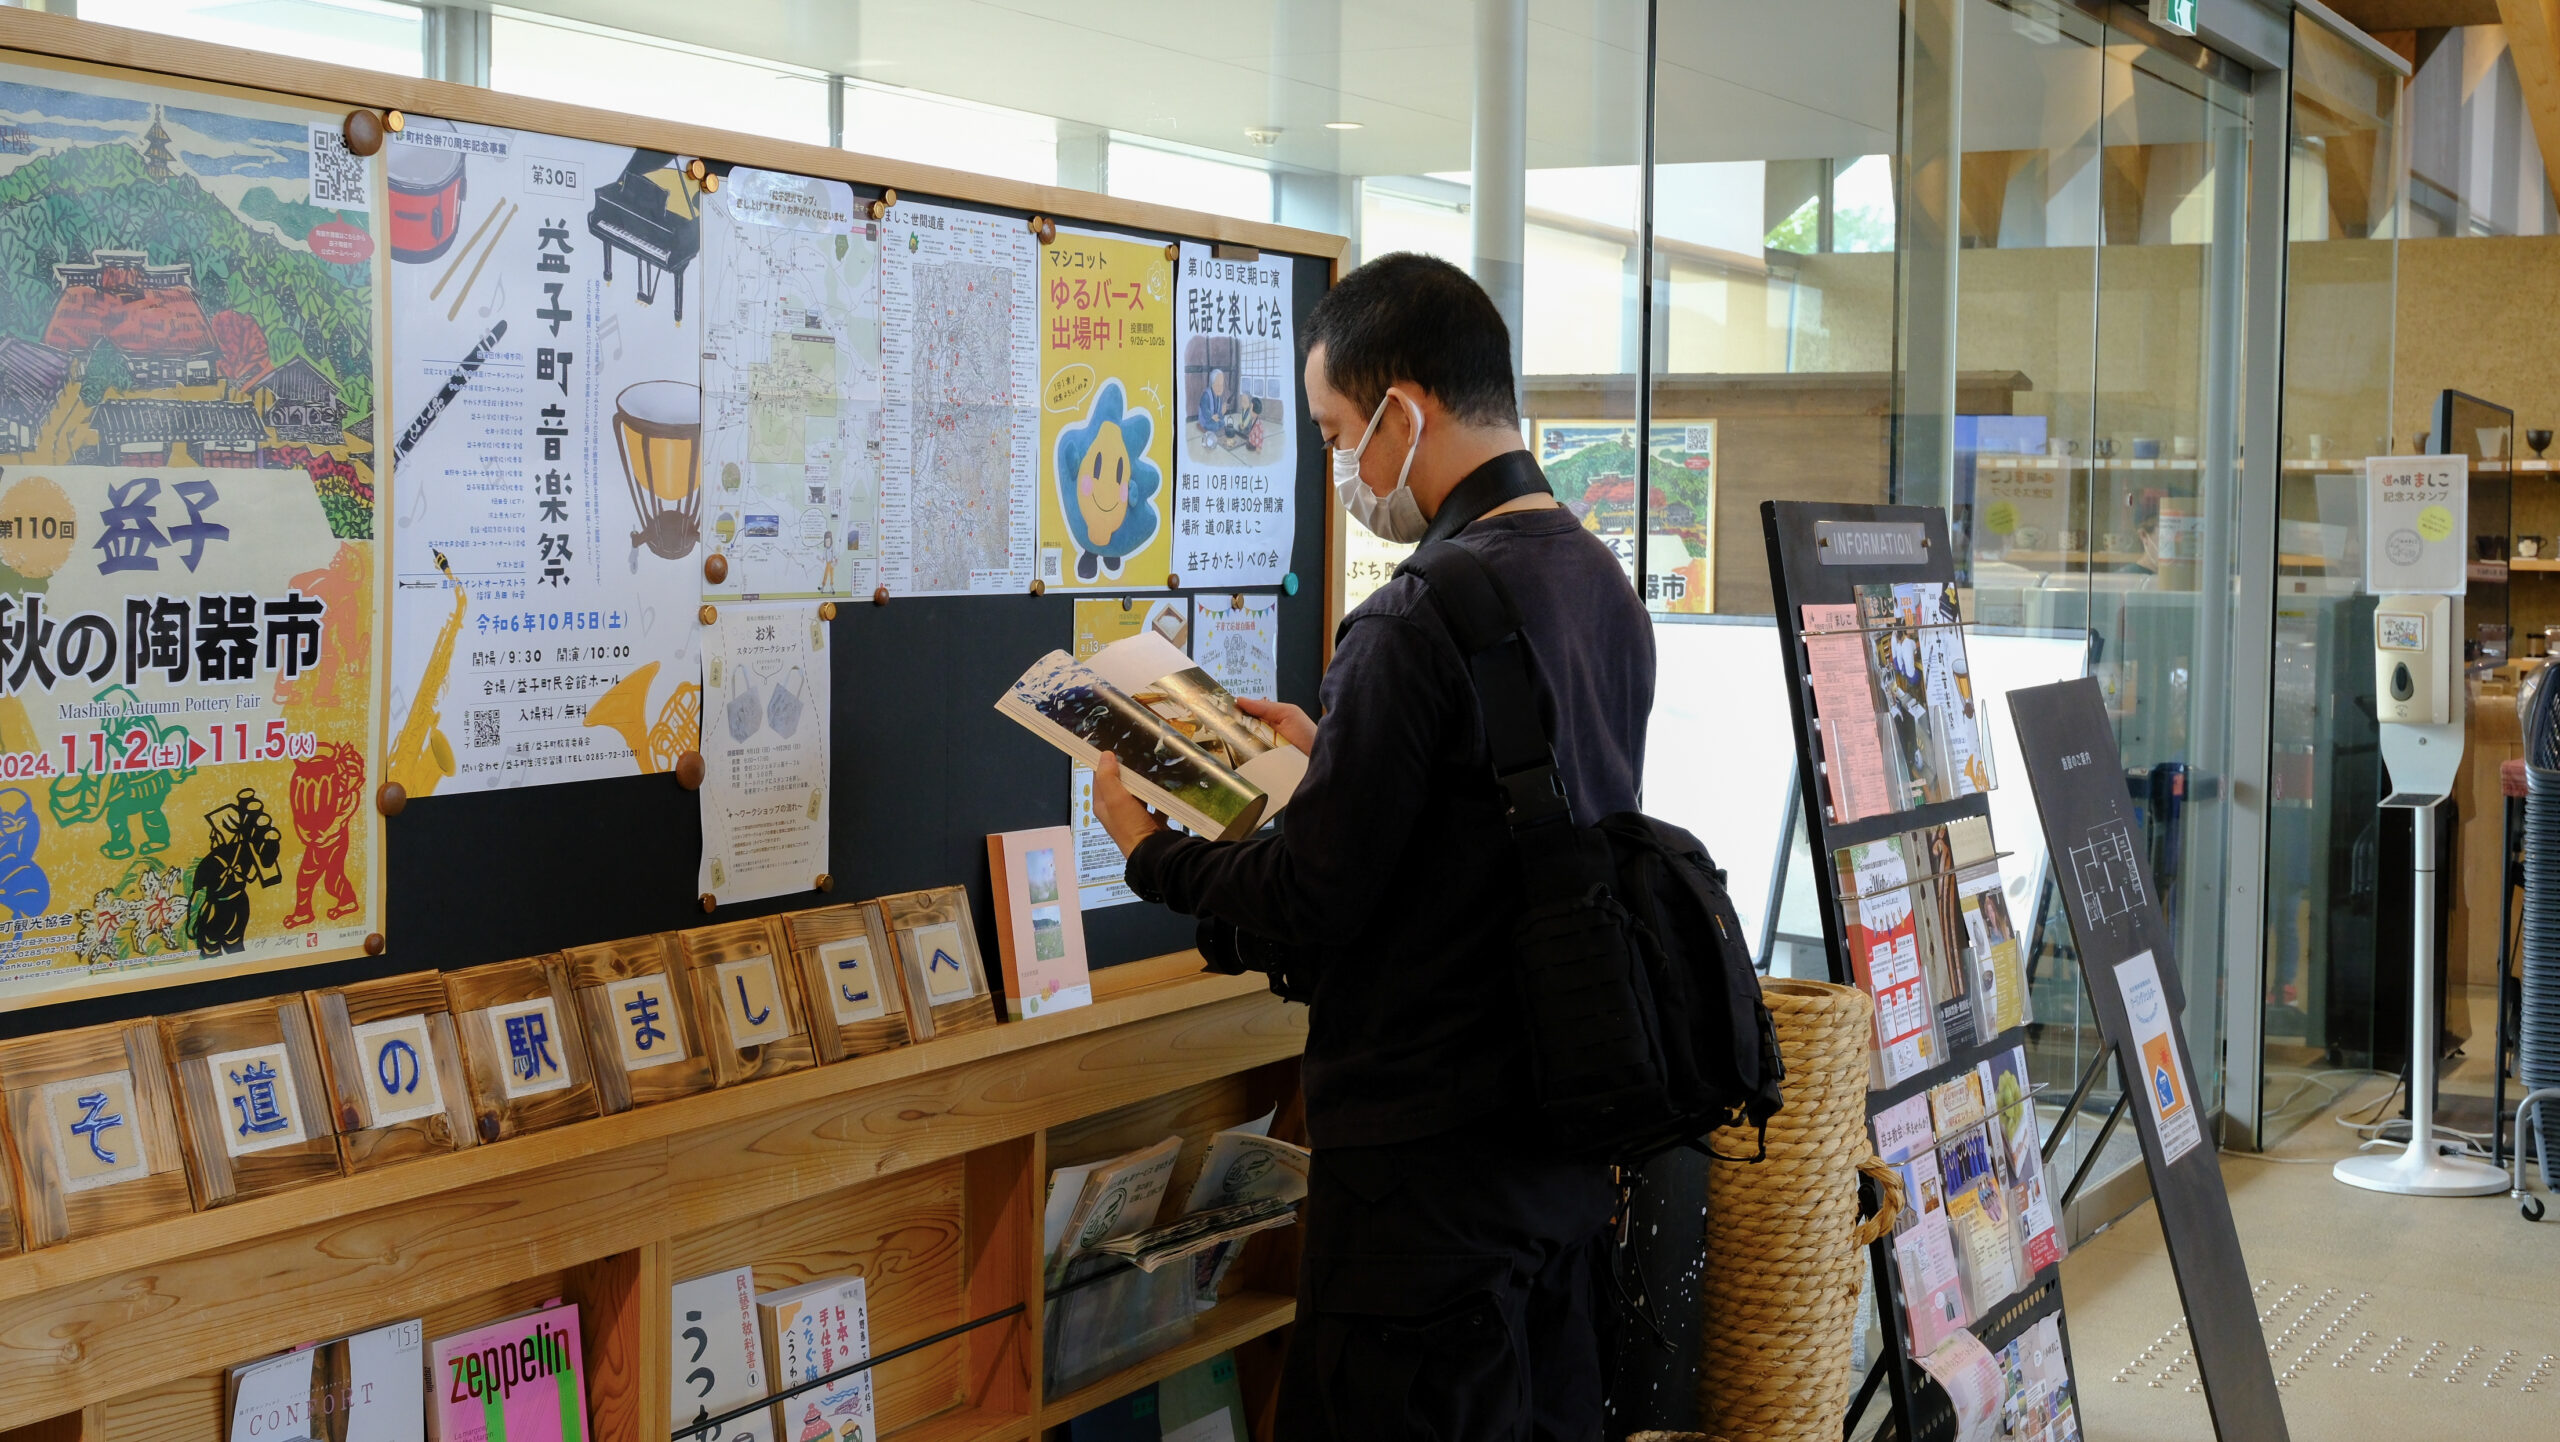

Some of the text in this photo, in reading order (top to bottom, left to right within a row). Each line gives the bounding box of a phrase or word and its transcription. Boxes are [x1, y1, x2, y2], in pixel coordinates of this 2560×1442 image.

[531, 164, 577, 188] 第30回
[884, 208, 946, 231] ましこ世間遺産
[1187, 256, 1281, 289] 第103回定期口演
[1050, 276, 1145, 311] ゆるバース
[1188, 287, 1282, 341] 民話を楽しむ会
[1051, 315, 1124, 351] 出場中!
[535, 217, 575, 589] 益子町音楽祭
[1182, 472, 1269, 494] 期日 10月19日(土)
[2382, 471, 2449, 488] 道の駅ましこ
[1181, 496, 1284, 514] 時間 午後1時30分開演
[2383, 490, 2449, 502] 記念スタンプ
[92, 477, 230, 576] 益子
[1181, 518, 1262, 536] 場所 道の駅ましこ
[1833, 531, 1914, 556] INFORMATION
[1187, 549, 1279, 571] 益子かたりべの会
[475, 609, 629, 636] 令和6年10月5日(土)
[755, 624, 776, 641] お米
[0, 593, 324, 694] 秋の陶器市
[736, 642, 797, 656] スタンプワークショップ
[59, 694, 261, 720] Mashiko Autumn Pottery Fair
[835, 1304, 850, 1357] 日本の
[448, 1321, 571, 1405] zeppelin
[249, 1382, 374, 1436] CONFORT
